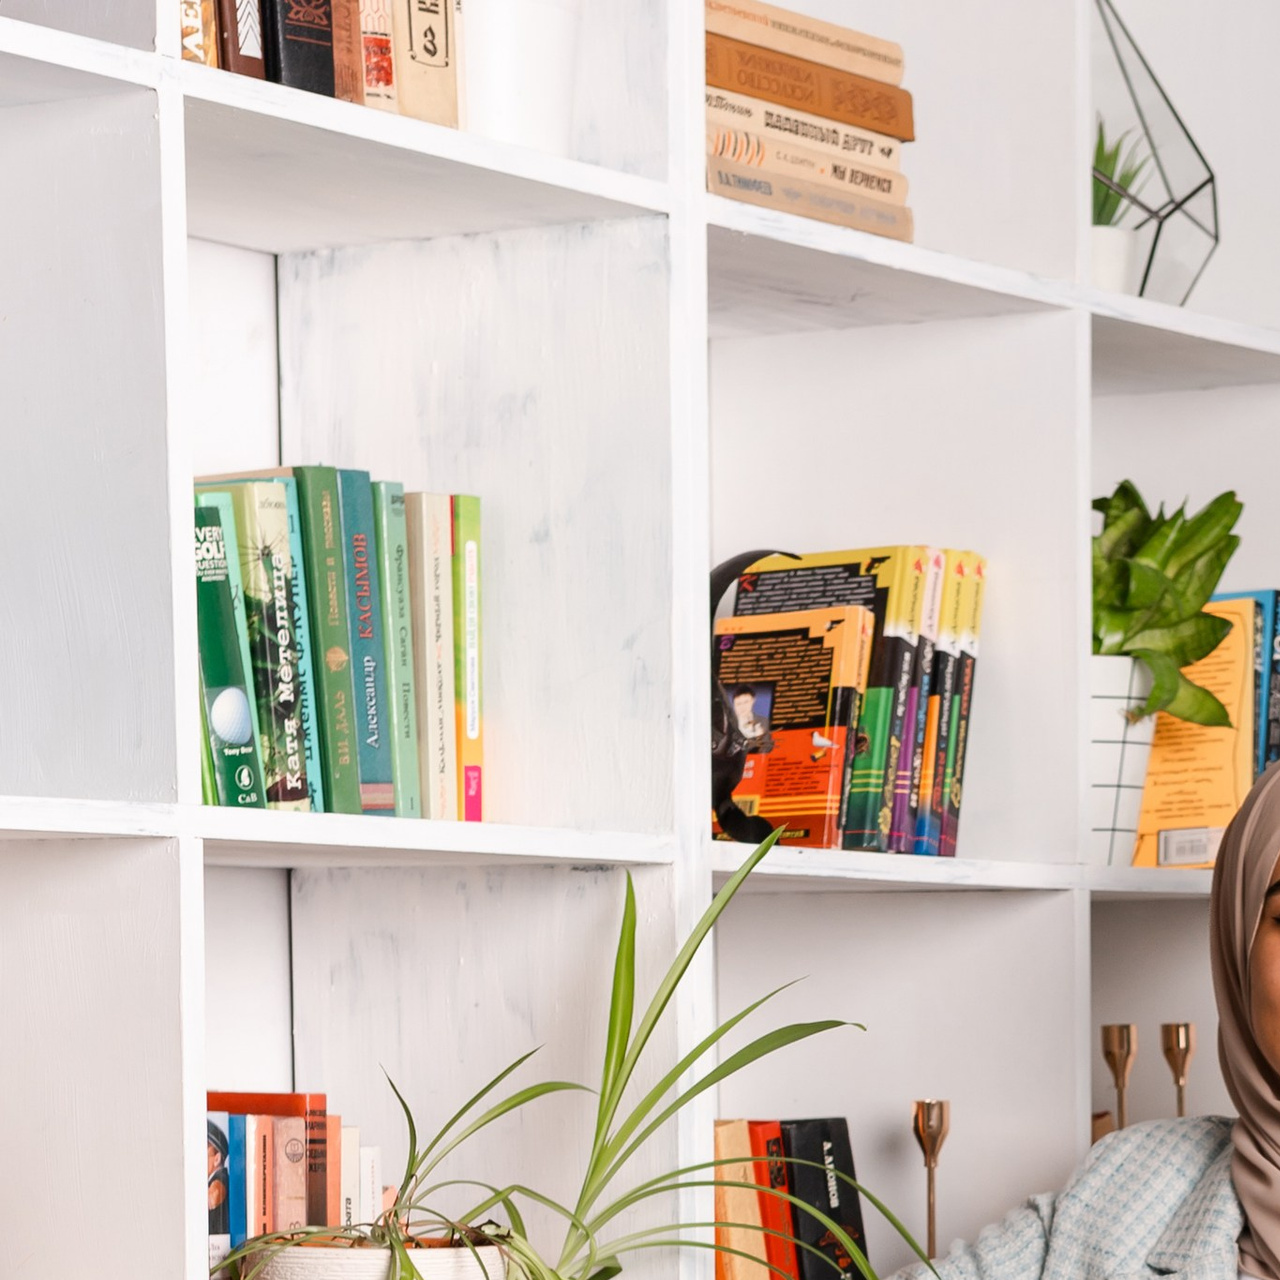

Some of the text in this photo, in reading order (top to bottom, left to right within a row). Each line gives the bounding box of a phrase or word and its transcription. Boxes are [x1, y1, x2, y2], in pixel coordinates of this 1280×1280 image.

[272, 552, 302, 790] Катя Метелица
[352, 533, 380, 749] Александр КАСЫМОВ
